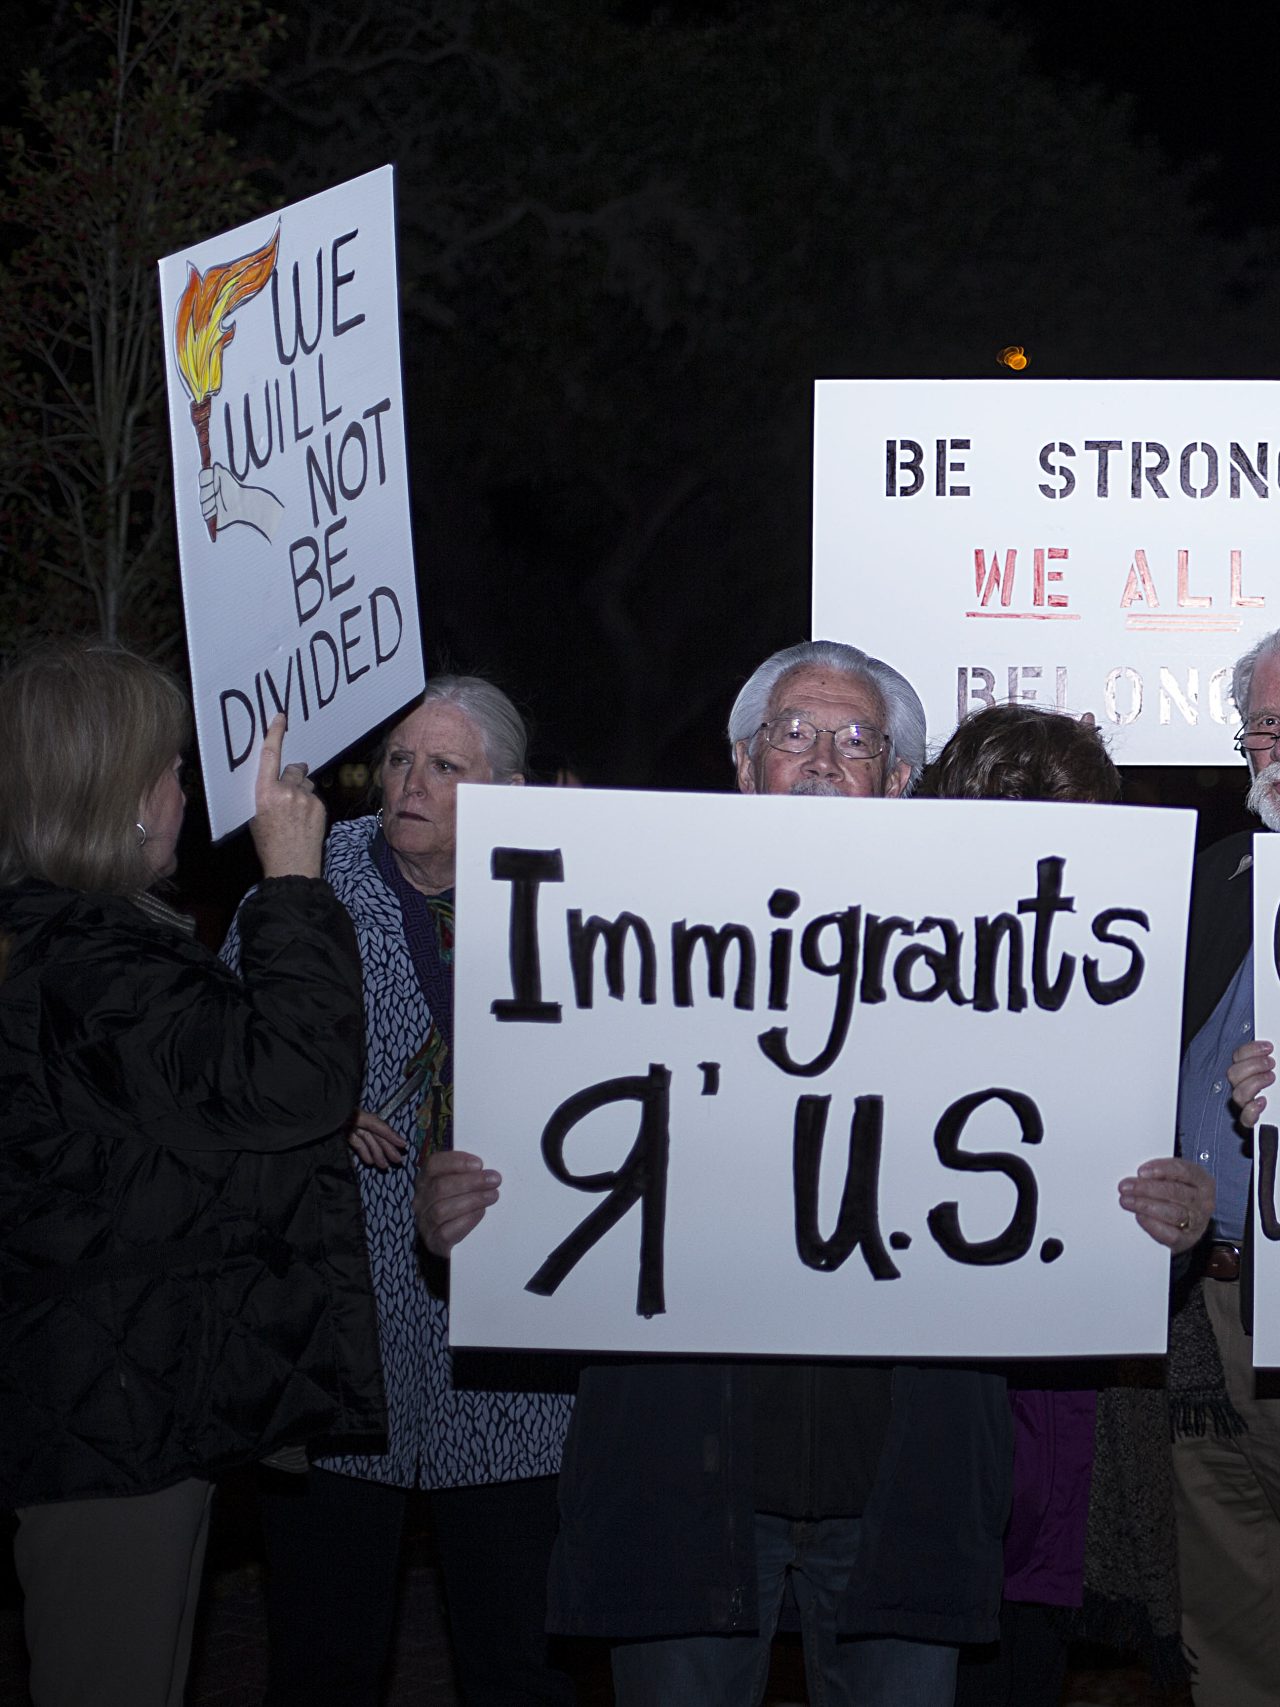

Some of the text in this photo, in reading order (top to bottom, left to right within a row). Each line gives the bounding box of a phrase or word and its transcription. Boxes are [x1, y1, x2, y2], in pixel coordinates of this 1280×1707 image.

[272, 228, 365, 365] WE
[225, 354, 343, 481] WILL
[306, 398, 391, 528] NOT
[885, 439, 971, 497] BE
[289, 516, 355, 627] BE
[974, 548, 1265, 608] WE ALL
[219, 586, 403, 772] DIVIDED
[490, 847, 1151, 1077] Immigrants
